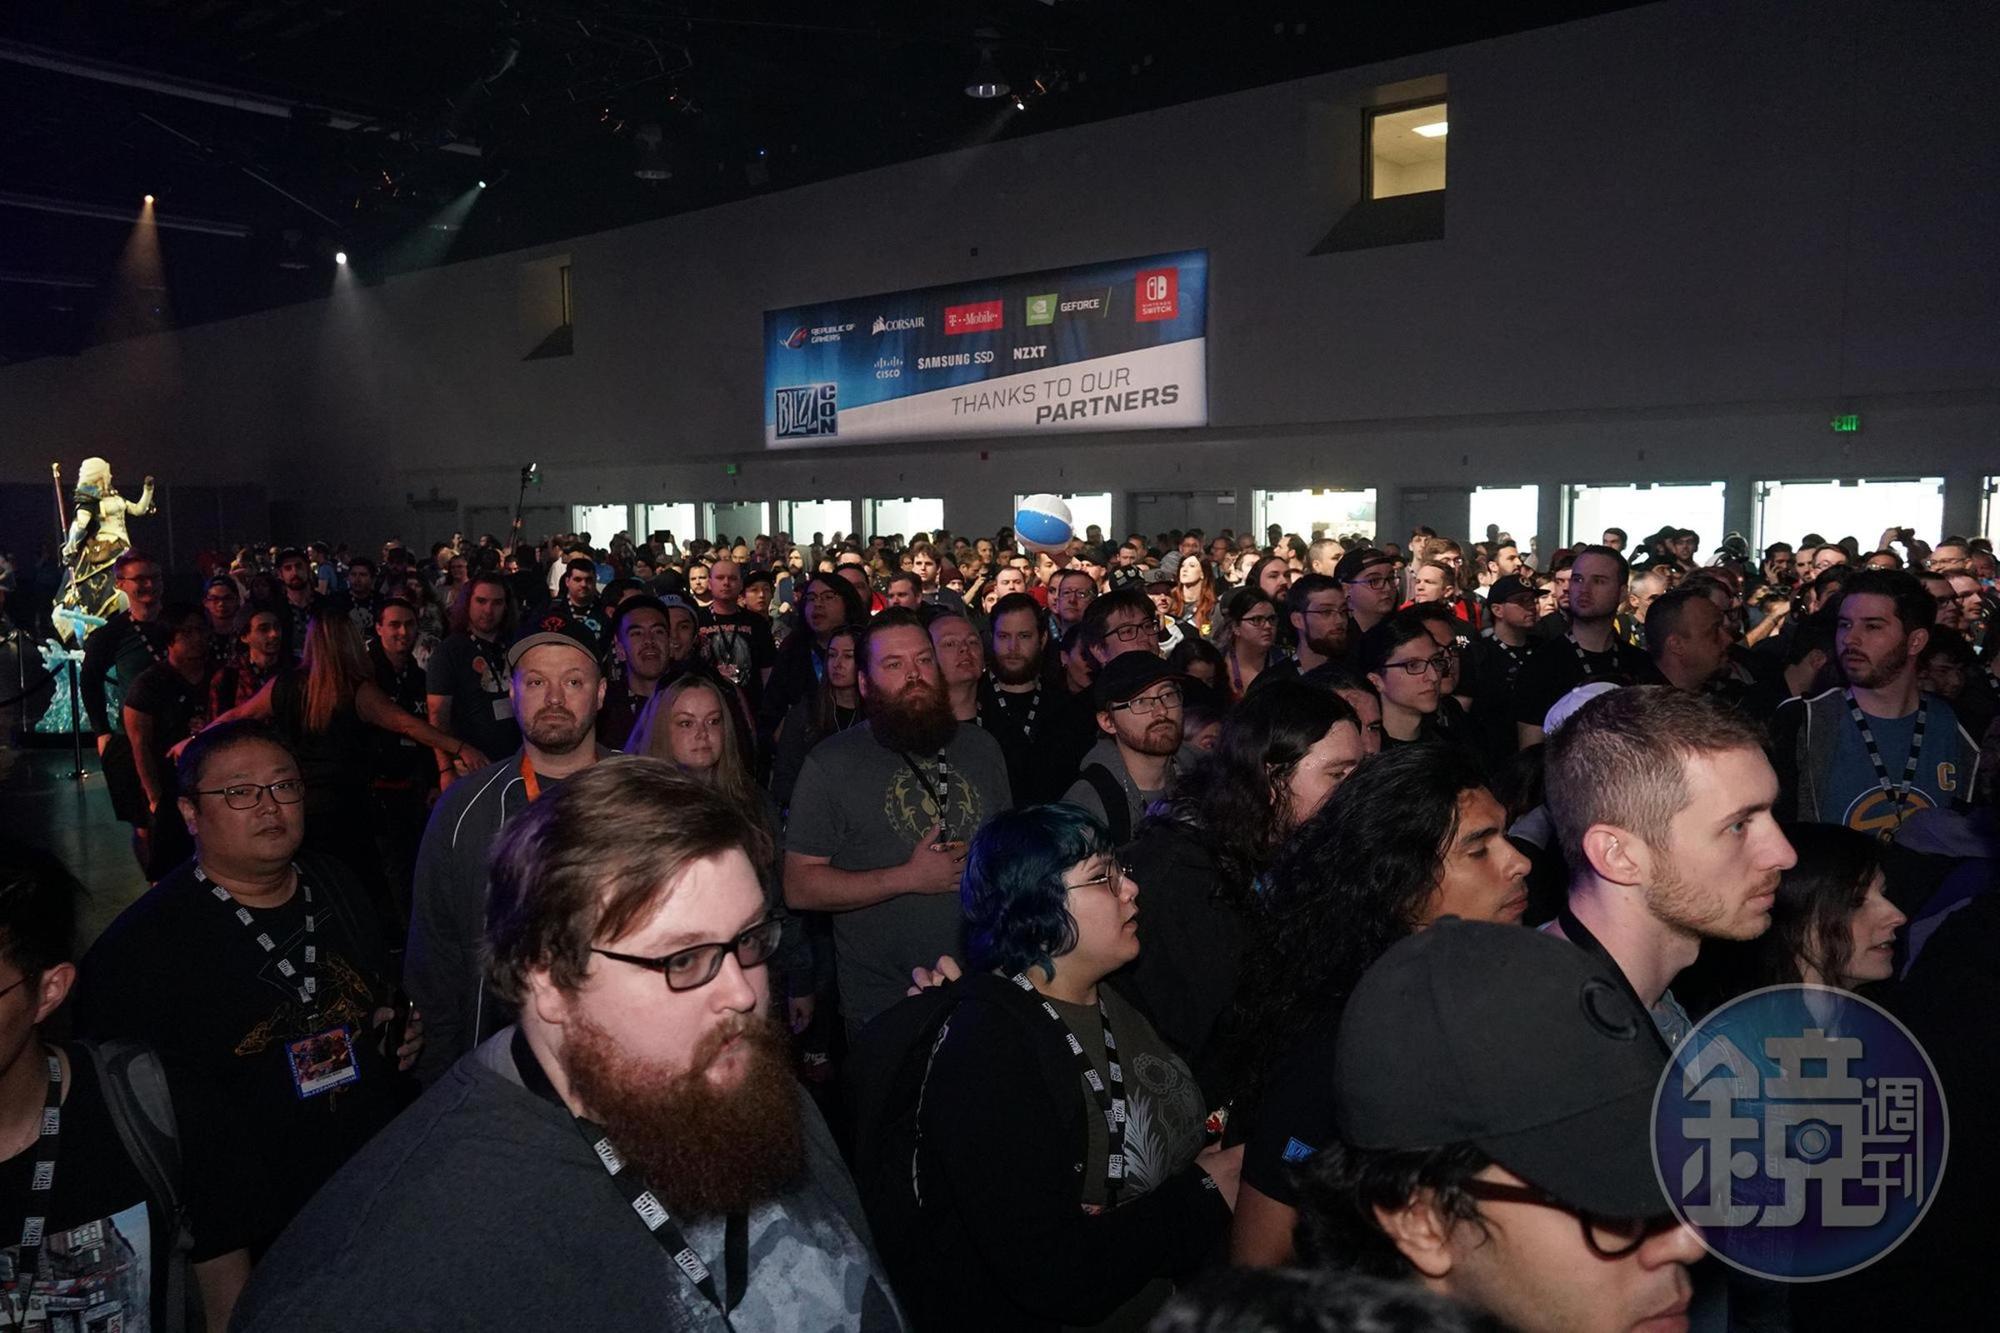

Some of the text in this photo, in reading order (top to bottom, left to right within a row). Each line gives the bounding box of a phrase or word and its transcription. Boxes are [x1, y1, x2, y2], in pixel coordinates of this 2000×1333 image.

[1060, 299, 1100, 312] GEFORCE
[1142, 306, 1172, 315] SWITCH
[811, 323, 855, 335] REPUBLIC OF
[885, 317, 925, 331] CORSAIR
[811, 334, 840, 344] GAMERS
[917, 351, 994, 369] SAMSUNG SSD
[1013, 346, 1047, 360] NZXT
[876, 369, 900, 379] CISCO
[952, 367, 1131, 416] THANKS TO OUR
[1036, 384, 1180, 425] PARTNERS
[1937, 762, 1957, 791] C
